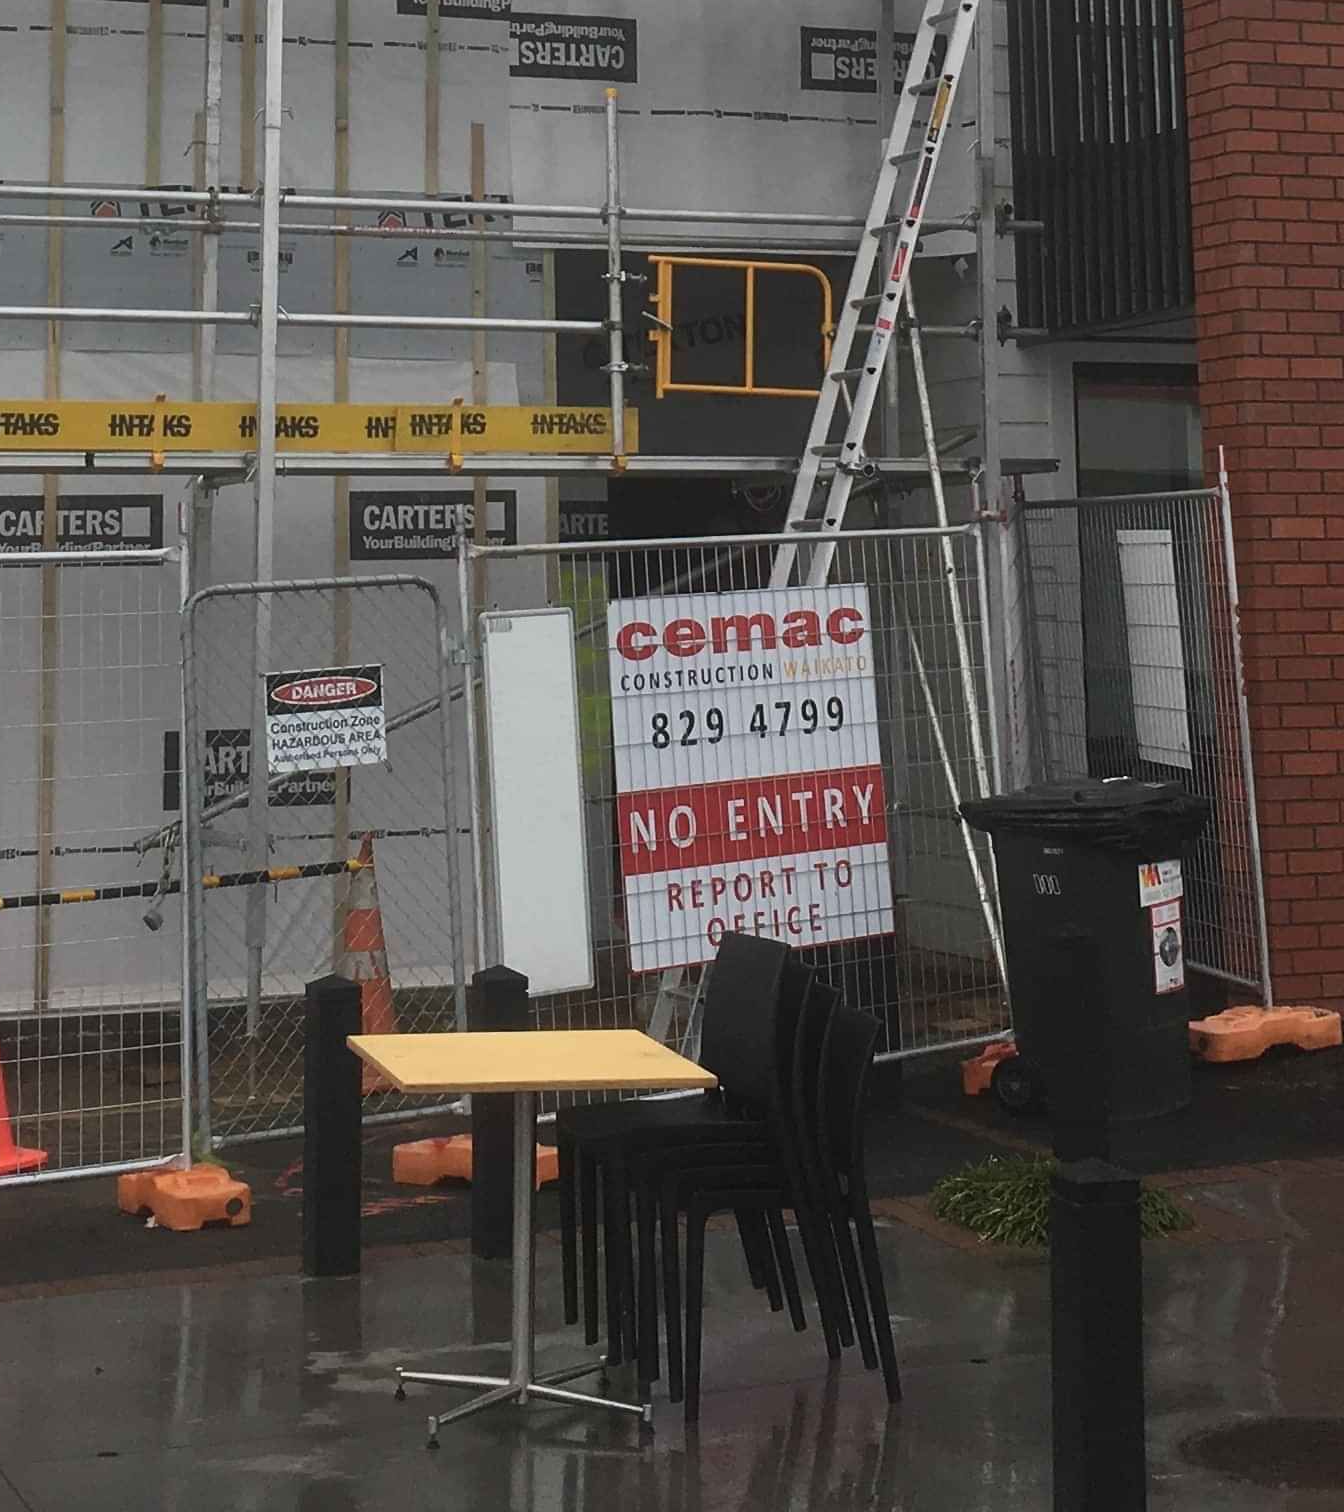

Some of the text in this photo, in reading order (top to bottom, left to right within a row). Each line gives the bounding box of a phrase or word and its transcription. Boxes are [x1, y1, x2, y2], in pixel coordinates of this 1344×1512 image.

[520, 41, 625, 69] CARTERS
[239, 414, 319, 439] INAKS
[531, 413, 606, 436] INTAKS
[617, 607, 865, 661] cemac
[291, 682, 357, 700] DANGER
[621, 663, 774, 692] CONSTRUCTION
[270, 719, 348, 735] Construction
[652, 696, 846, 750] 829 4799
[272, 729, 382, 750] HAZARDOUS AREA
[630, 783, 875, 854] NO ENTRY
[668, 859, 853, 912] REPORT TO
[707, 903, 823, 948] OFFICE
